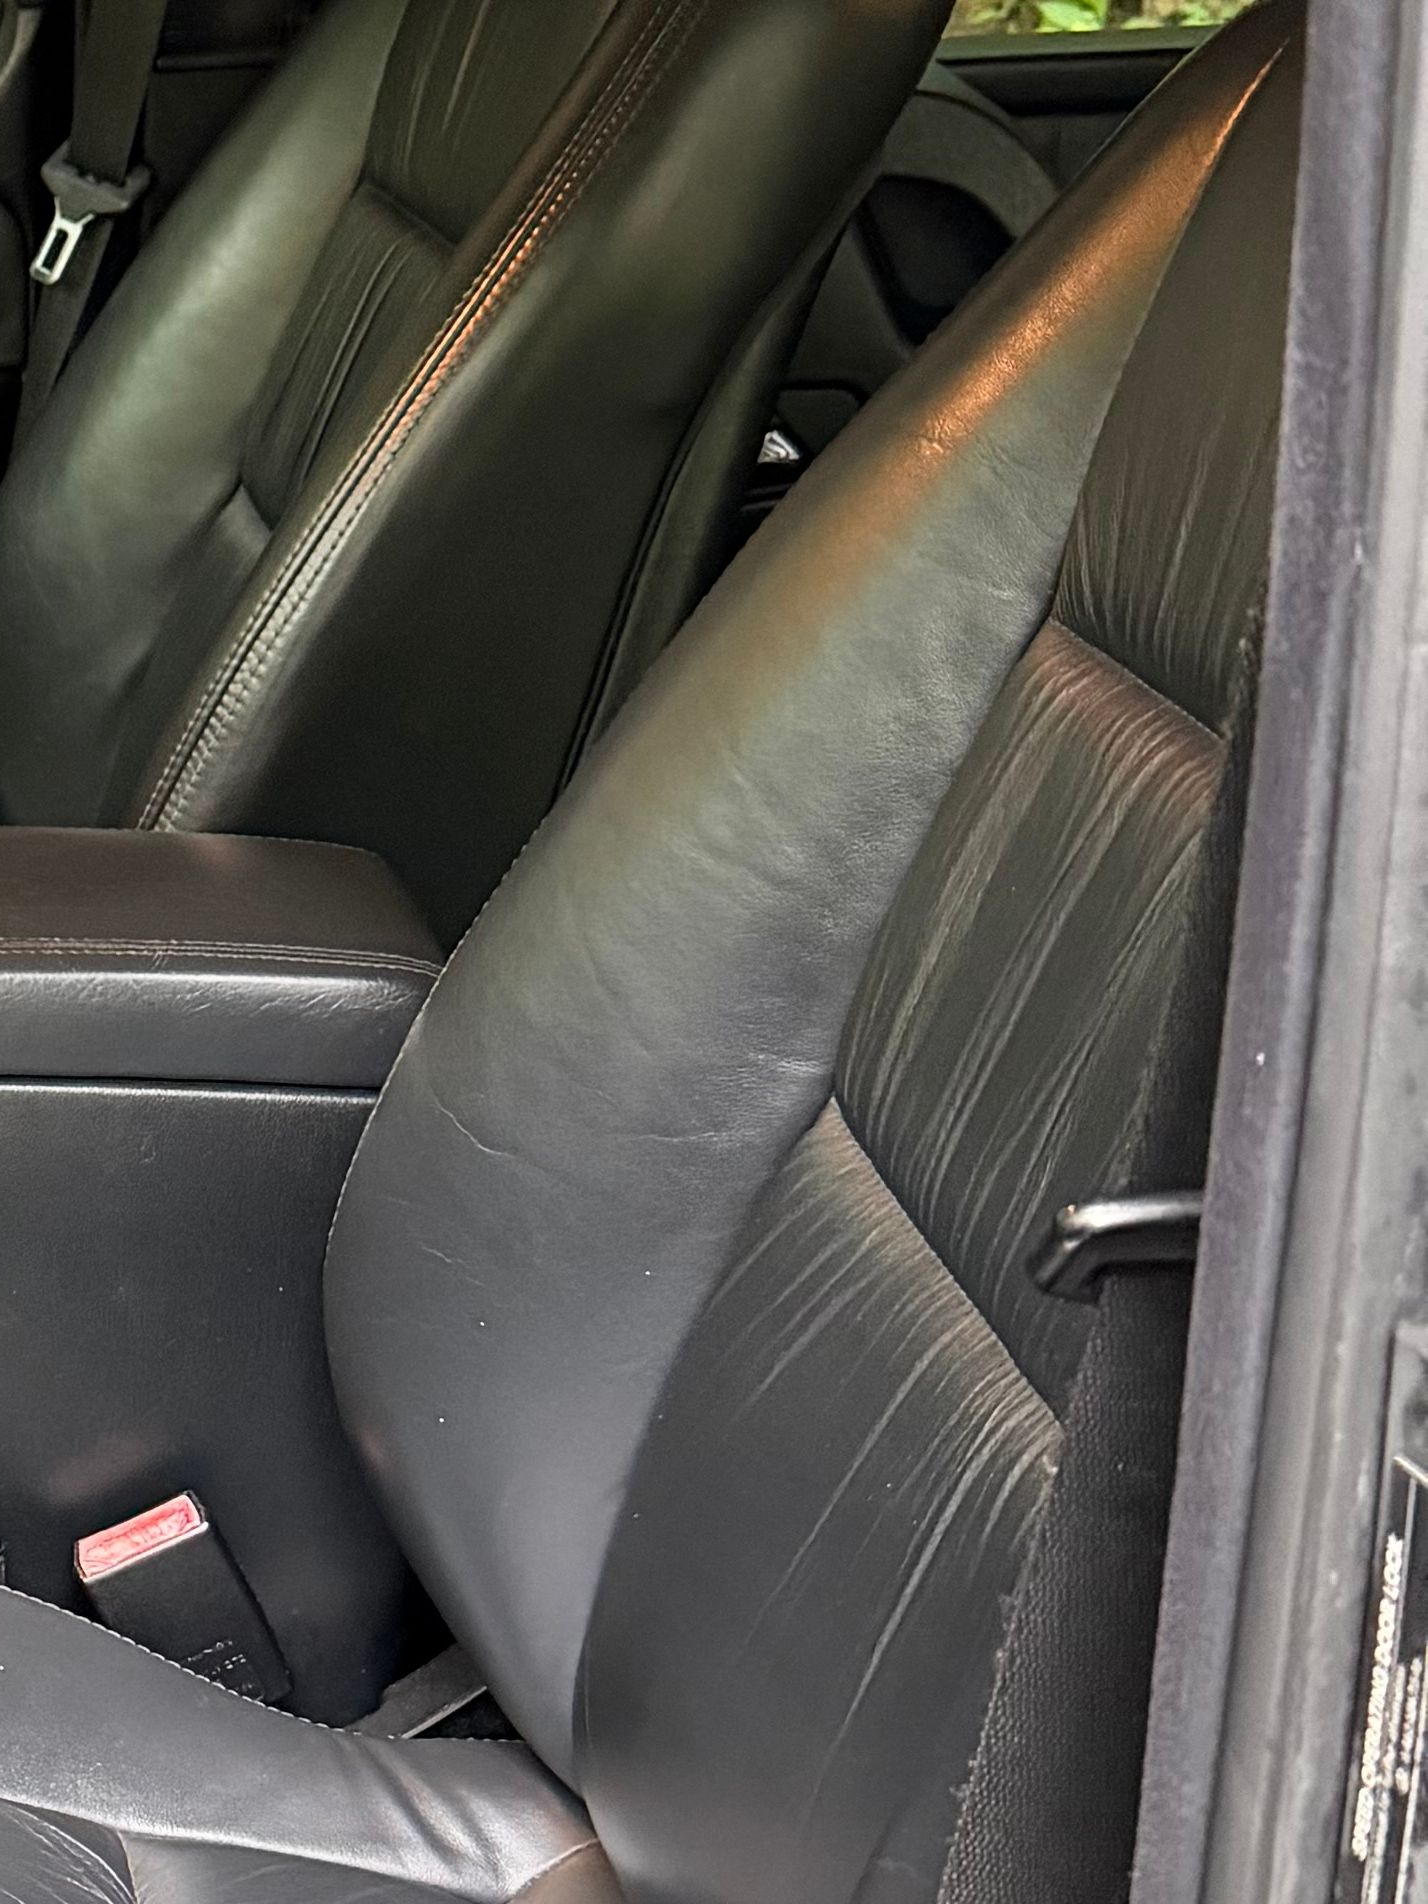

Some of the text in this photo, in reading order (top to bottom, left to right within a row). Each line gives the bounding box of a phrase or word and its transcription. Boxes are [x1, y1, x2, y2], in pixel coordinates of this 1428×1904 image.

[1383, 1532, 1404, 1600] LOCK
[1374, 1597, 1397, 1668] DOOR
[1361, 1665, 1390, 1788] OPERATING
